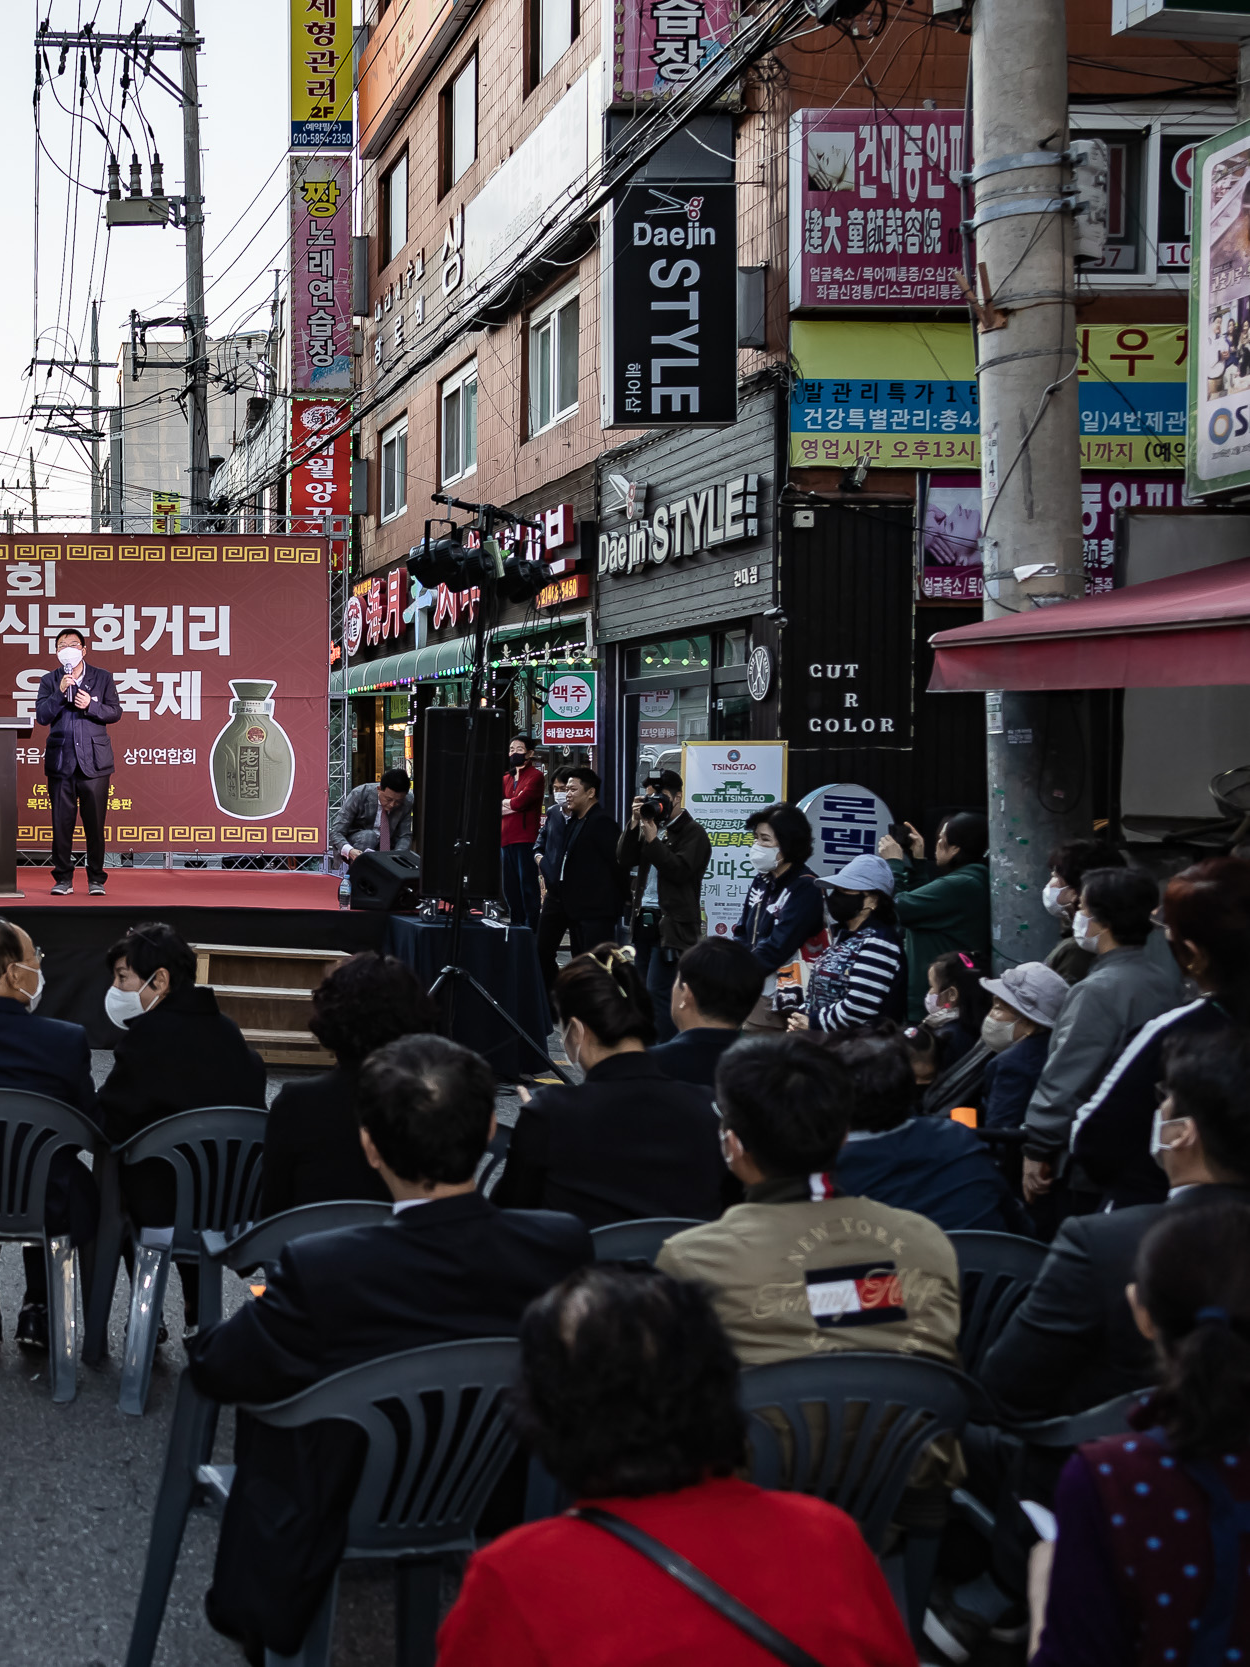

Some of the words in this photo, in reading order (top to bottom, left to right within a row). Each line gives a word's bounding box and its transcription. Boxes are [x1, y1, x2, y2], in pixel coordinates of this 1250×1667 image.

[310, 106, 334, 118] 2F
[302, 181, 341, 218] 짱
[633, 221, 717, 250] Daejin
[307, 220, 337, 368] 노래연습장
[649, 257, 701, 415] STYLE
[625, 362, 642, 413] 헤어샵
[800, 438, 883, 461] 영업시간
[304, 433, 338, 527] 해월양꼬
[598, 521, 650, 576] Daejin
[652, 473, 748, 564] STYLE
[5, 561, 56, 598] 회
[734, 565, 759, 588] 건대점
[808, 663, 859, 679] CUT
[553, 685, 588, 702] 맥주
[843, 692, 859, 708] R
[558, 705, 581, 713] 칭따오
[545, 727, 594, 739] 해월양꼬치
[808, 718, 895, 733] COLOR
[122, 747, 197, 765] 상인연합회
[711, 763, 757, 771] TSINGTAO
[701, 794, 724, 802] WITH
[725, 794, 766, 802] TSINGTAO
